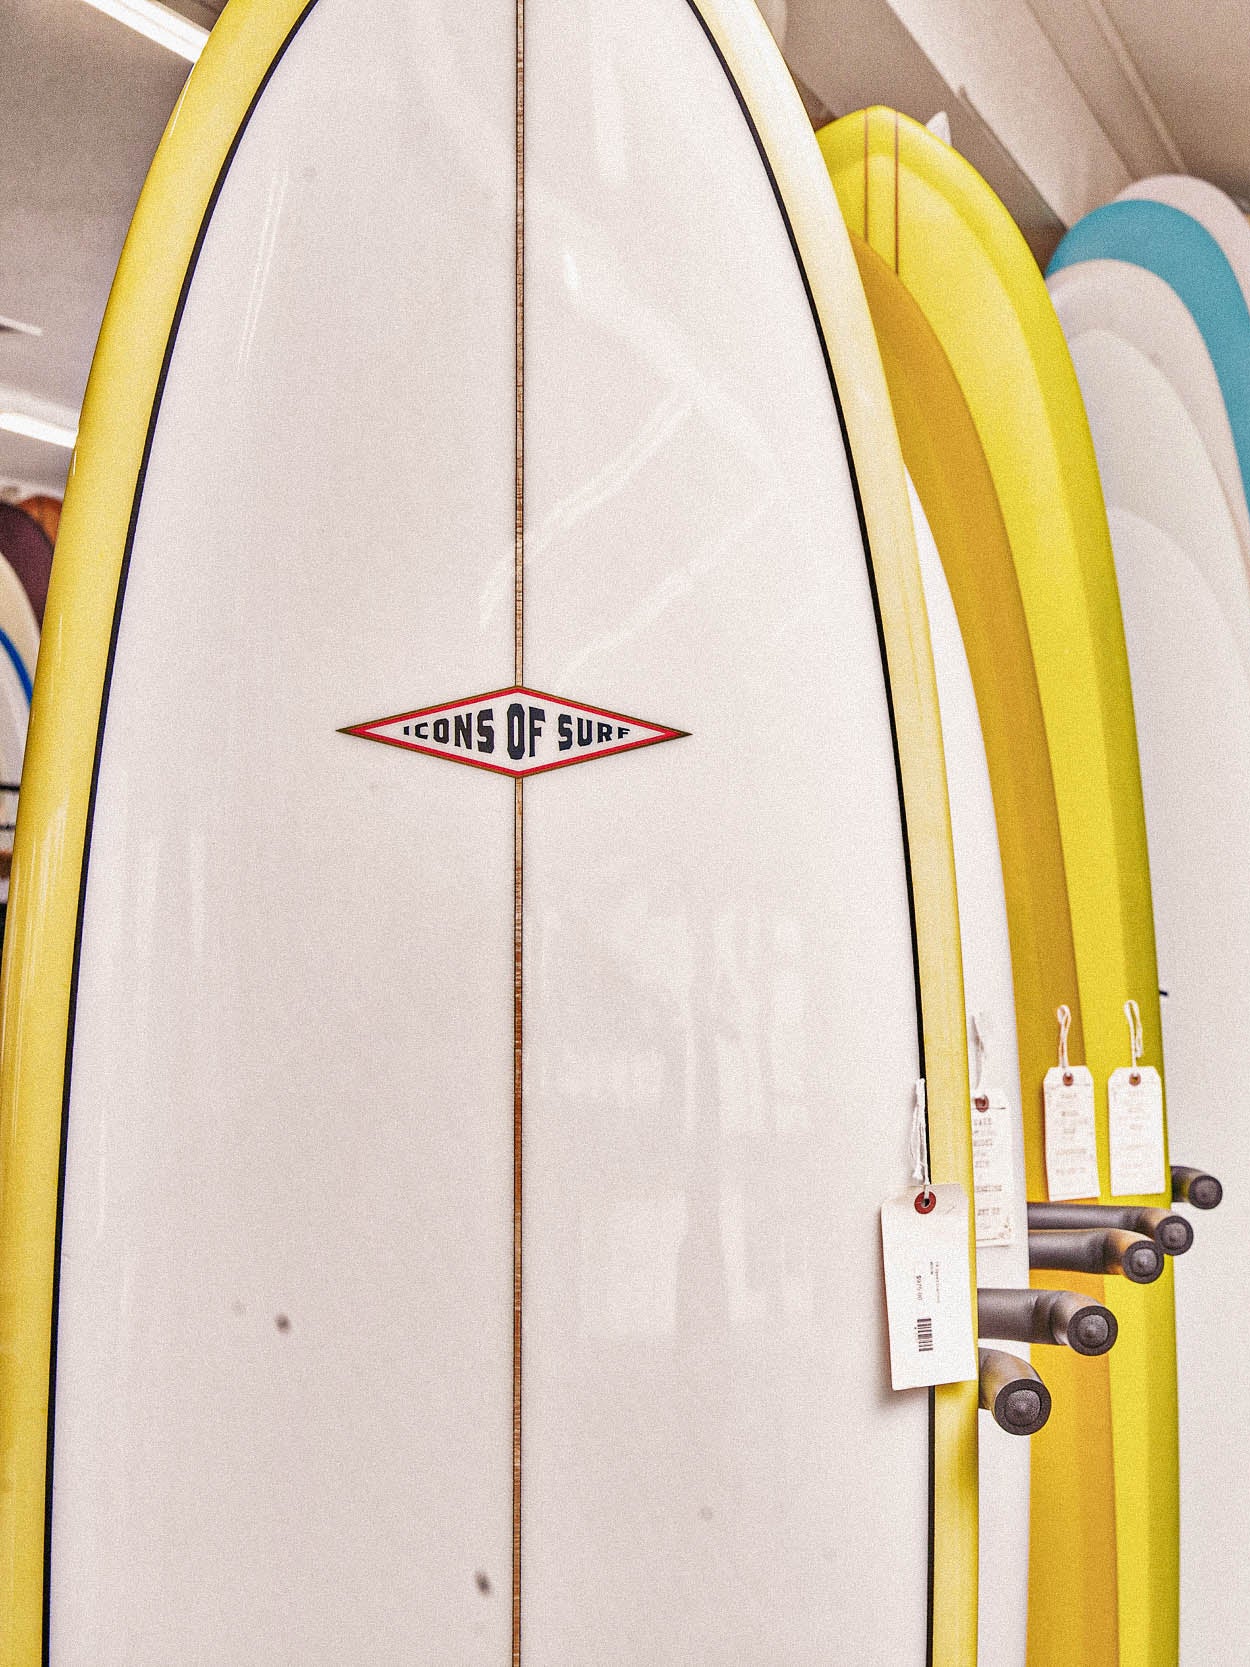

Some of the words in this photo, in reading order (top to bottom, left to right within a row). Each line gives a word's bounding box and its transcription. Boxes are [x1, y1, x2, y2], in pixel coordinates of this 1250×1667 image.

[404, 708, 495, 754] ICONS
[506, 703, 546, 760] OF
[558, 713, 631, 751] SURF
